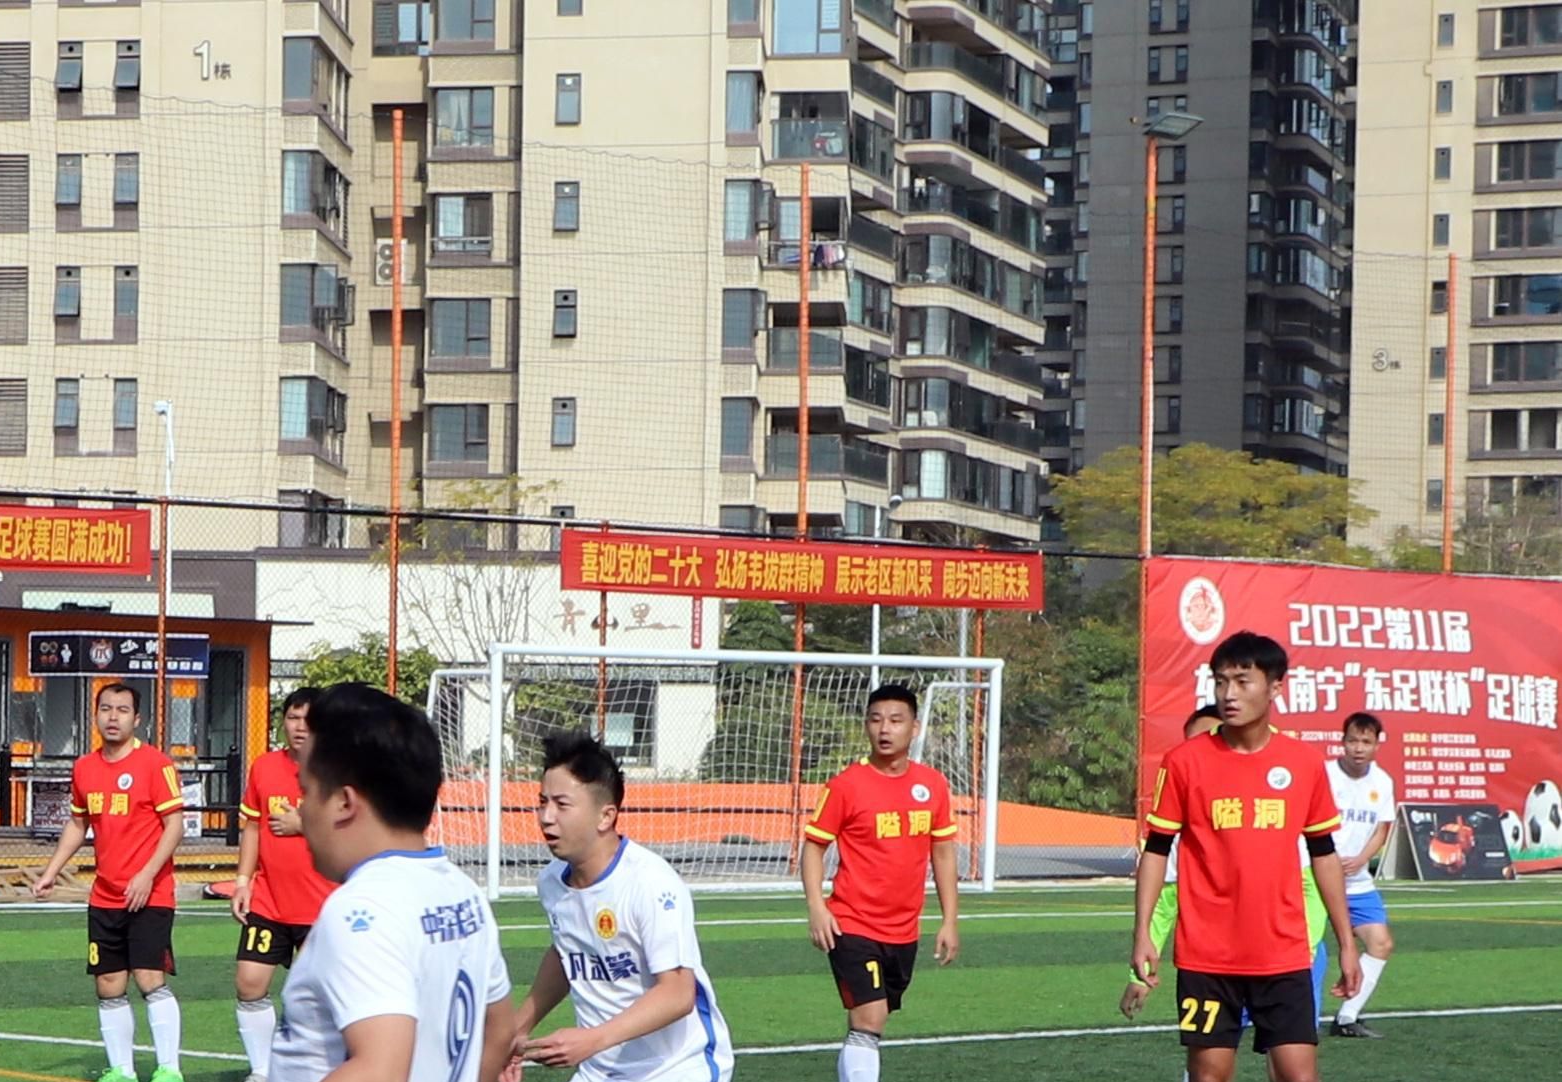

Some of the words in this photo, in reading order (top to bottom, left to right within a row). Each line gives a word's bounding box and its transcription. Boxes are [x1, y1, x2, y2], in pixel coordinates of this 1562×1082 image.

[581, 541, 703, 588] 喜迎党的二十大
[715, 548, 825, 593] 弘扬韦拔群精神
[835, 555, 933, 598] 展示老区新风采
[1287, 602, 1472, 652] 2022第11届
[1212, 797, 1285, 830] 隘洞
[246, 926, 272, 953] 13
[1180, 997, 1220, 1034] 27
